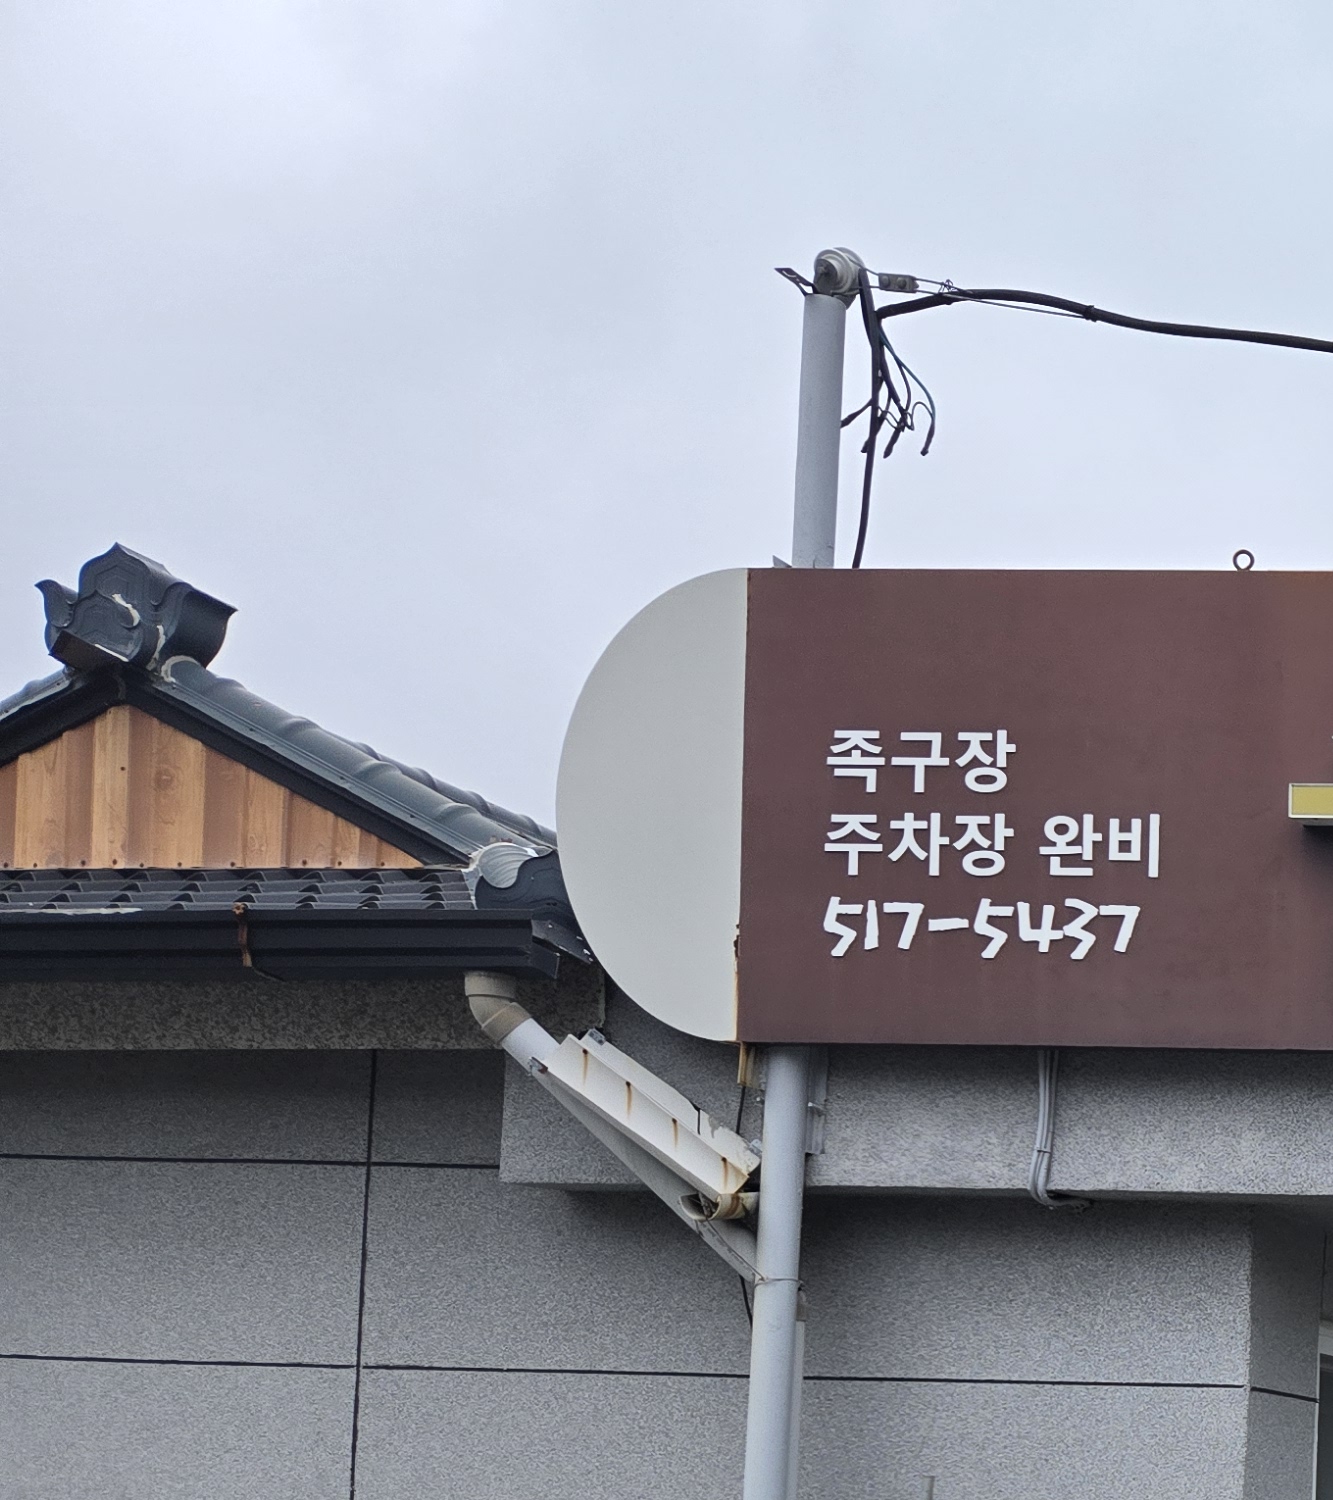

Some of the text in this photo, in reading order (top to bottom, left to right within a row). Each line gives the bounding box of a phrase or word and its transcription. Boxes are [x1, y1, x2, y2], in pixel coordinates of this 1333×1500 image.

[825, 729, 1017, 794] 족구장
[824, 812, 1161, 878] 주차장 완비
[823, 896, 1141, 960] 517-5437
